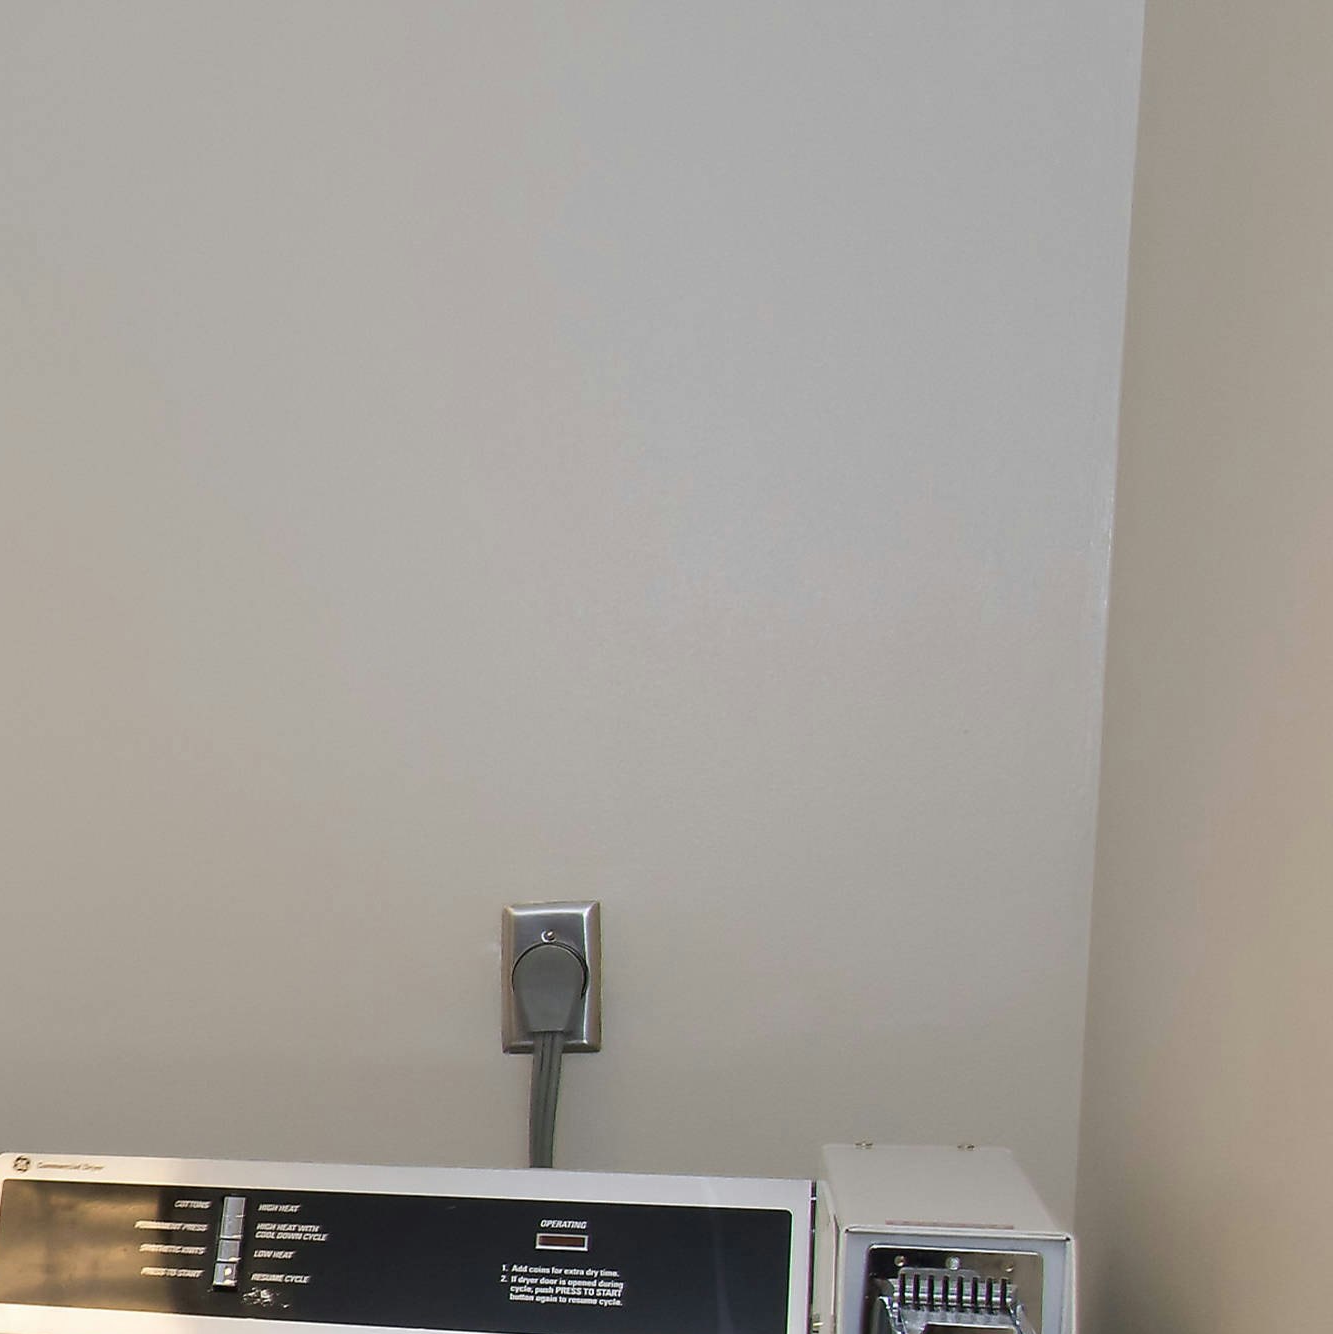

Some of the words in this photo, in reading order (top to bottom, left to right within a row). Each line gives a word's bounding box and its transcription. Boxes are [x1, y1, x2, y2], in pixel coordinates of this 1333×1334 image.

[278, 1204, 301, 1212] HEAT
[540, 1220, 587, 1229] OPERATING
[276, 1232, 302, 1240] DOWN
[303, 1233, 329, 1241] CYCLE
[253, 1250, 273, 1258] LOW
[273, 1251, 296, 1259] HEAT
[502, 1264, 508, 1272] 1.
[511, 1265, 527, 1273] Add
[564, 1268, 584, 1276] extra
[585, 1268, 599, 1278] dry
[600, 1269, 619, 1277] time.
[284, 1275, 311, 1283] CYCLE
[501, 1275, 507, 1283] 2.
[511, 1275, 518, 1283] If
[518, 1276, 538, 1285] dryer
[539, 1277, 558, 1285] door
[568, 1279, 596, 1288] opened
[598, 1280, 624, 1290] during
[509, 1285, 534, 1295] cycle,
[534, 1286, 554, 1295] push
[555, 1286, 582, 1295] PRESS
[583, 1287, 595, 1296] TO
[596, 1288, 622, 1297] START
[509, 1293, 534, 1301] button
[535, 1295, 558, 1304] again
[598, 1297, 623, 1307] cycle.
